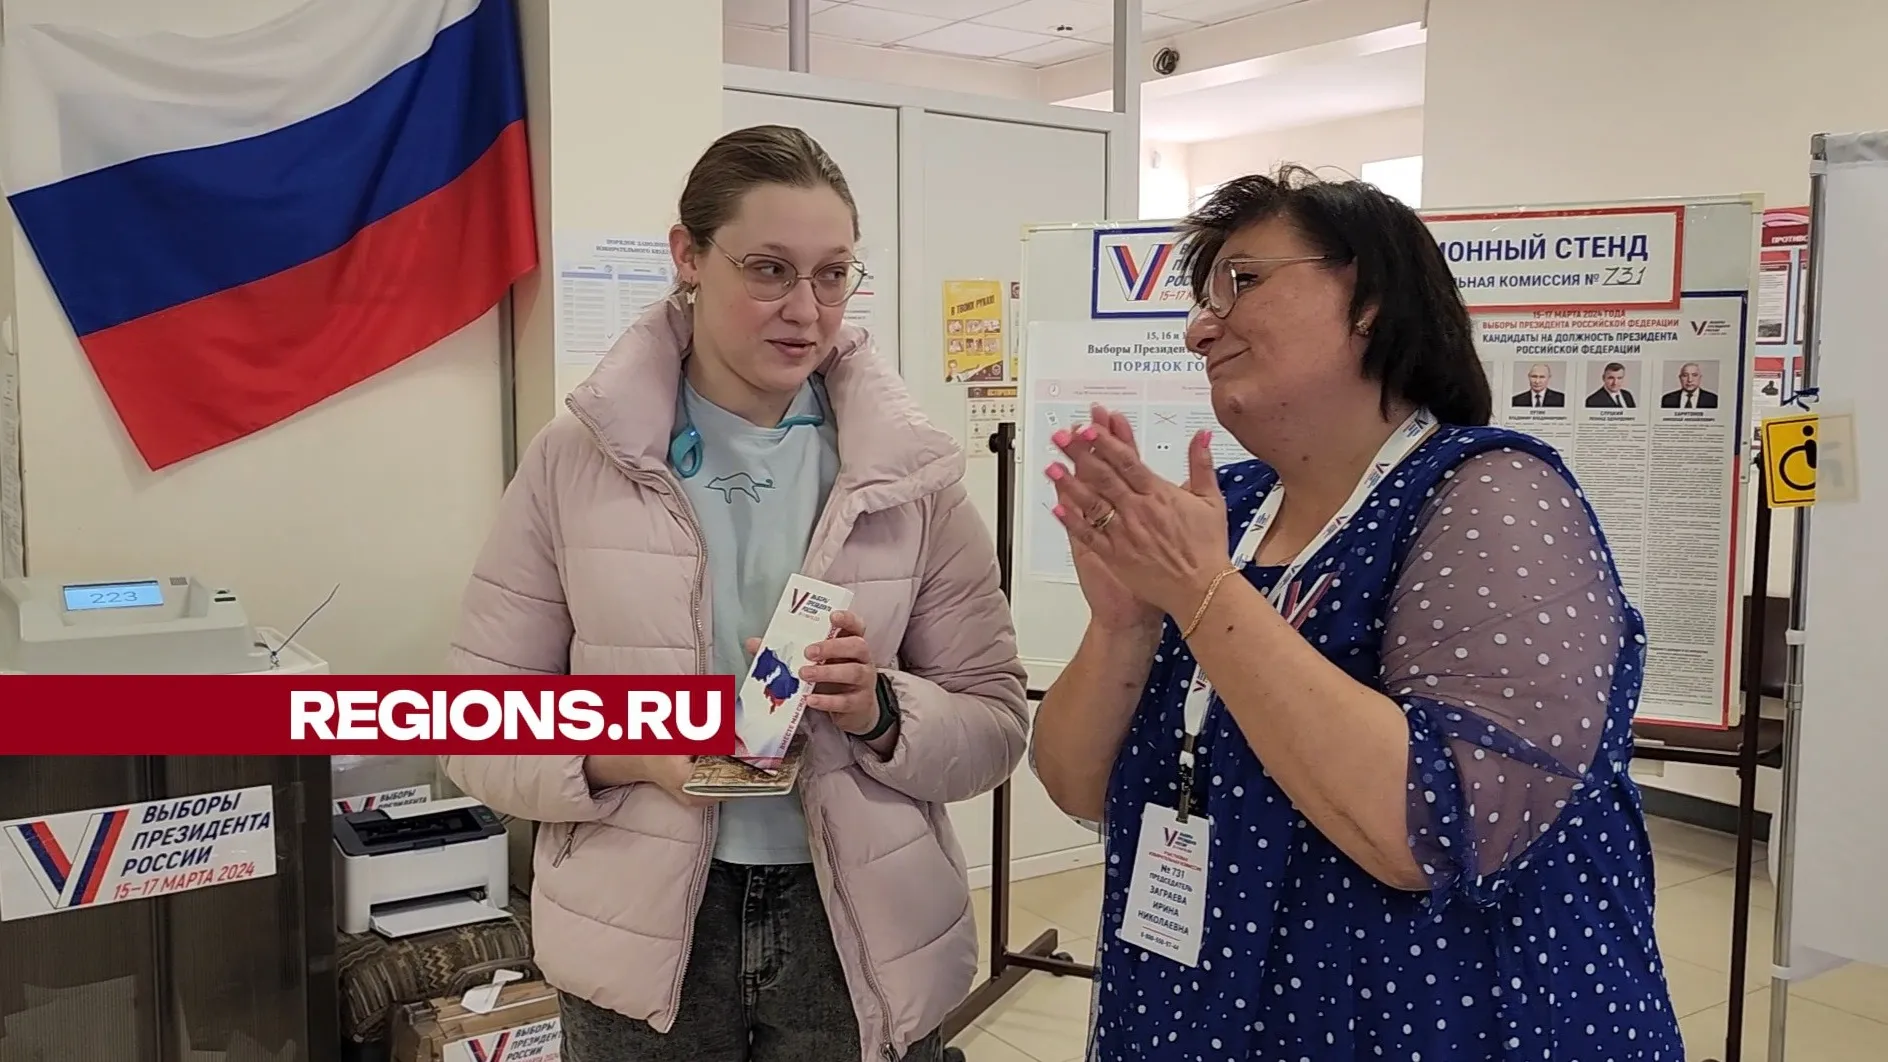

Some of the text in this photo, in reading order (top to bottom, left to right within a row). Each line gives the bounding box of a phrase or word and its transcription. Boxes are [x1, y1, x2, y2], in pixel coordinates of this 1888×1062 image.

[1555, 234, 1648, 262] СТЕНД
[1499, 273, 1580, 288] КОМИССИЯ
[1584, 273, 1600, 286] №
[1602, 266, 1647, 286] 731
[1554, 309, 1582, 318] МАРТА
[1604, 309, 1626, 318] ГОДА
[1482, 318, 1679, 330] ВЫБОРЫ ПРЕЗИДЕНТА РОССИЙСКОЙ ФЕДЕРАЦИИ
[1162, 331, 1172, 340] 16
[1482, 331, 1678, 344] КАНДИДАТЫ НА ДОЛЖНОСТЬ ПРЕЗИДЕНТА
[1088, 344, 1130, 356] Выборы
[1516, 343, 1641, 355] РОССИЙСКОЙ ФЕДЕРАЦИИ
[1113, 361, 1204, 373] ПОРЯДОК ГО
[90, 591, 138, 604] 223
[380, 789, 416, 801] ВЫБОРЫ
[142, 792, 242, 824] ВЫБОРЫ
[131, 811, 271, 851] ПРЕЗИДЕНТА
[121, 846, 213, 877] РОССИИ
[161, 869, 214, 893] МАРТА
[217, 861, 256, 882] 2024
[1172, 866, 1185, 879] 731
[1150, 872, 1193, 892] ПРЕДСЕДАТЕЛЬ
[1150, 885, 1188, 905] ЗАГРАЕВА
[1152, 901, 1180, 917] ИРИНА
[1138, 910, 1190, 935] НИКОЛАЕВНА
[515, 1021, 556, 1038] ВЫБОРЫ
[510, 1031, 561, 1050] ПРЕЗИДЕН
[506, 1046, 543, 1061] РОССИИ
